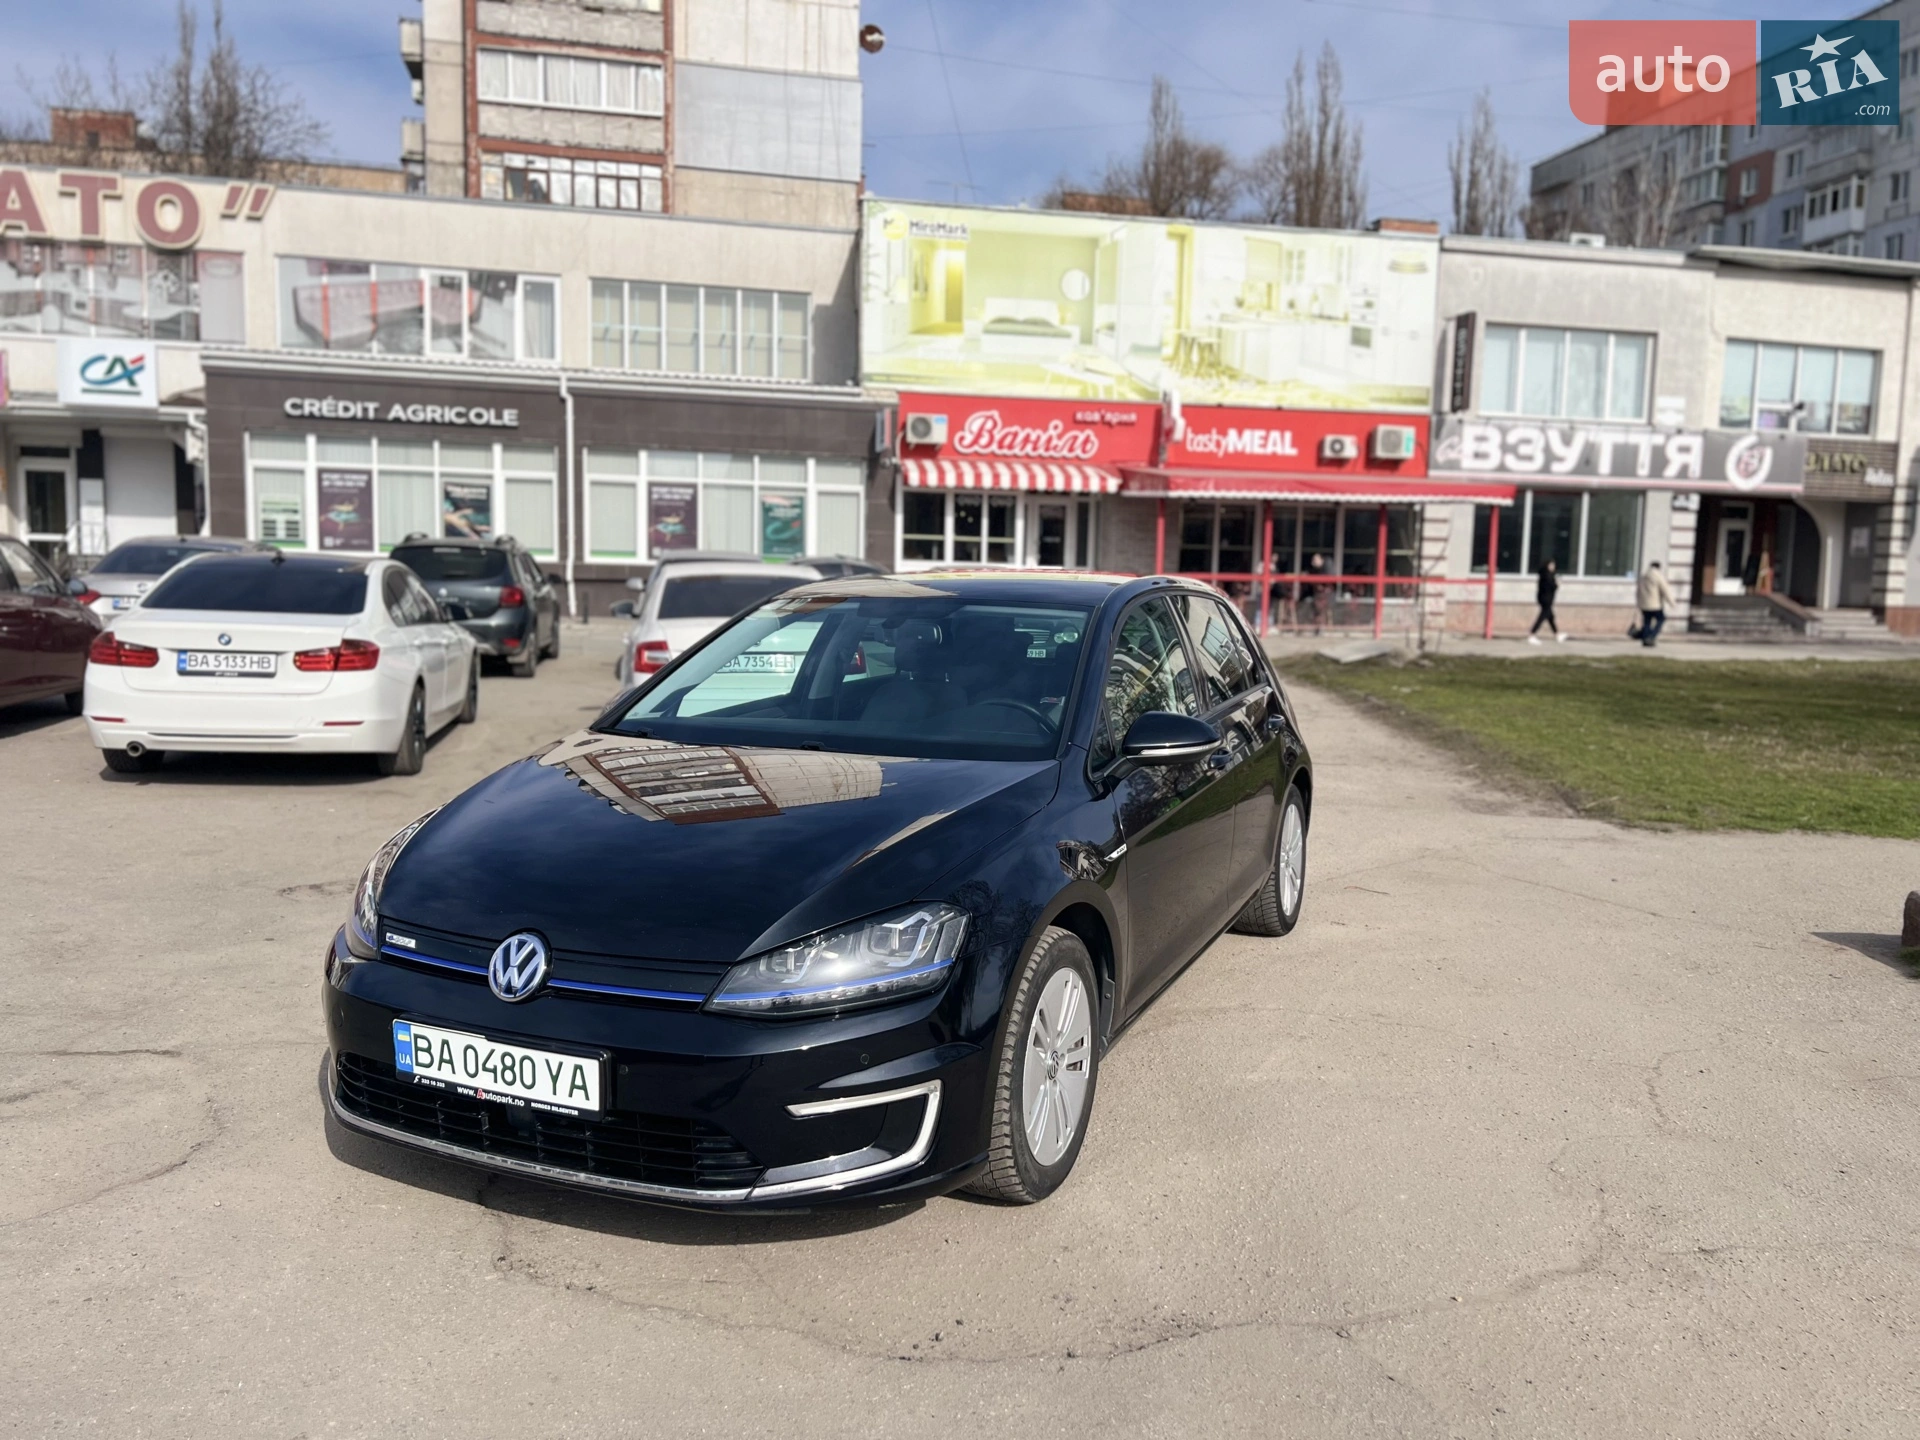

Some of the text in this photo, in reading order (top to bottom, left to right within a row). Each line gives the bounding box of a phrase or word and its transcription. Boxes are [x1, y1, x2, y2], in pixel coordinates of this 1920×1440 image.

[284, 395, 519, 426] CRÉDIT AGRICOLE
[953, 410, 1099, 459] Ваніль
[1461, 425, 1704, 479] ВЗУТТЯ
[187, 655, 272, 670] BA 5133 HB
[744, 656, 773, 668] 7354
[399, 1052, 412, 1066] UA
[413, 1032, 591, 1101] BA 0480 YA
